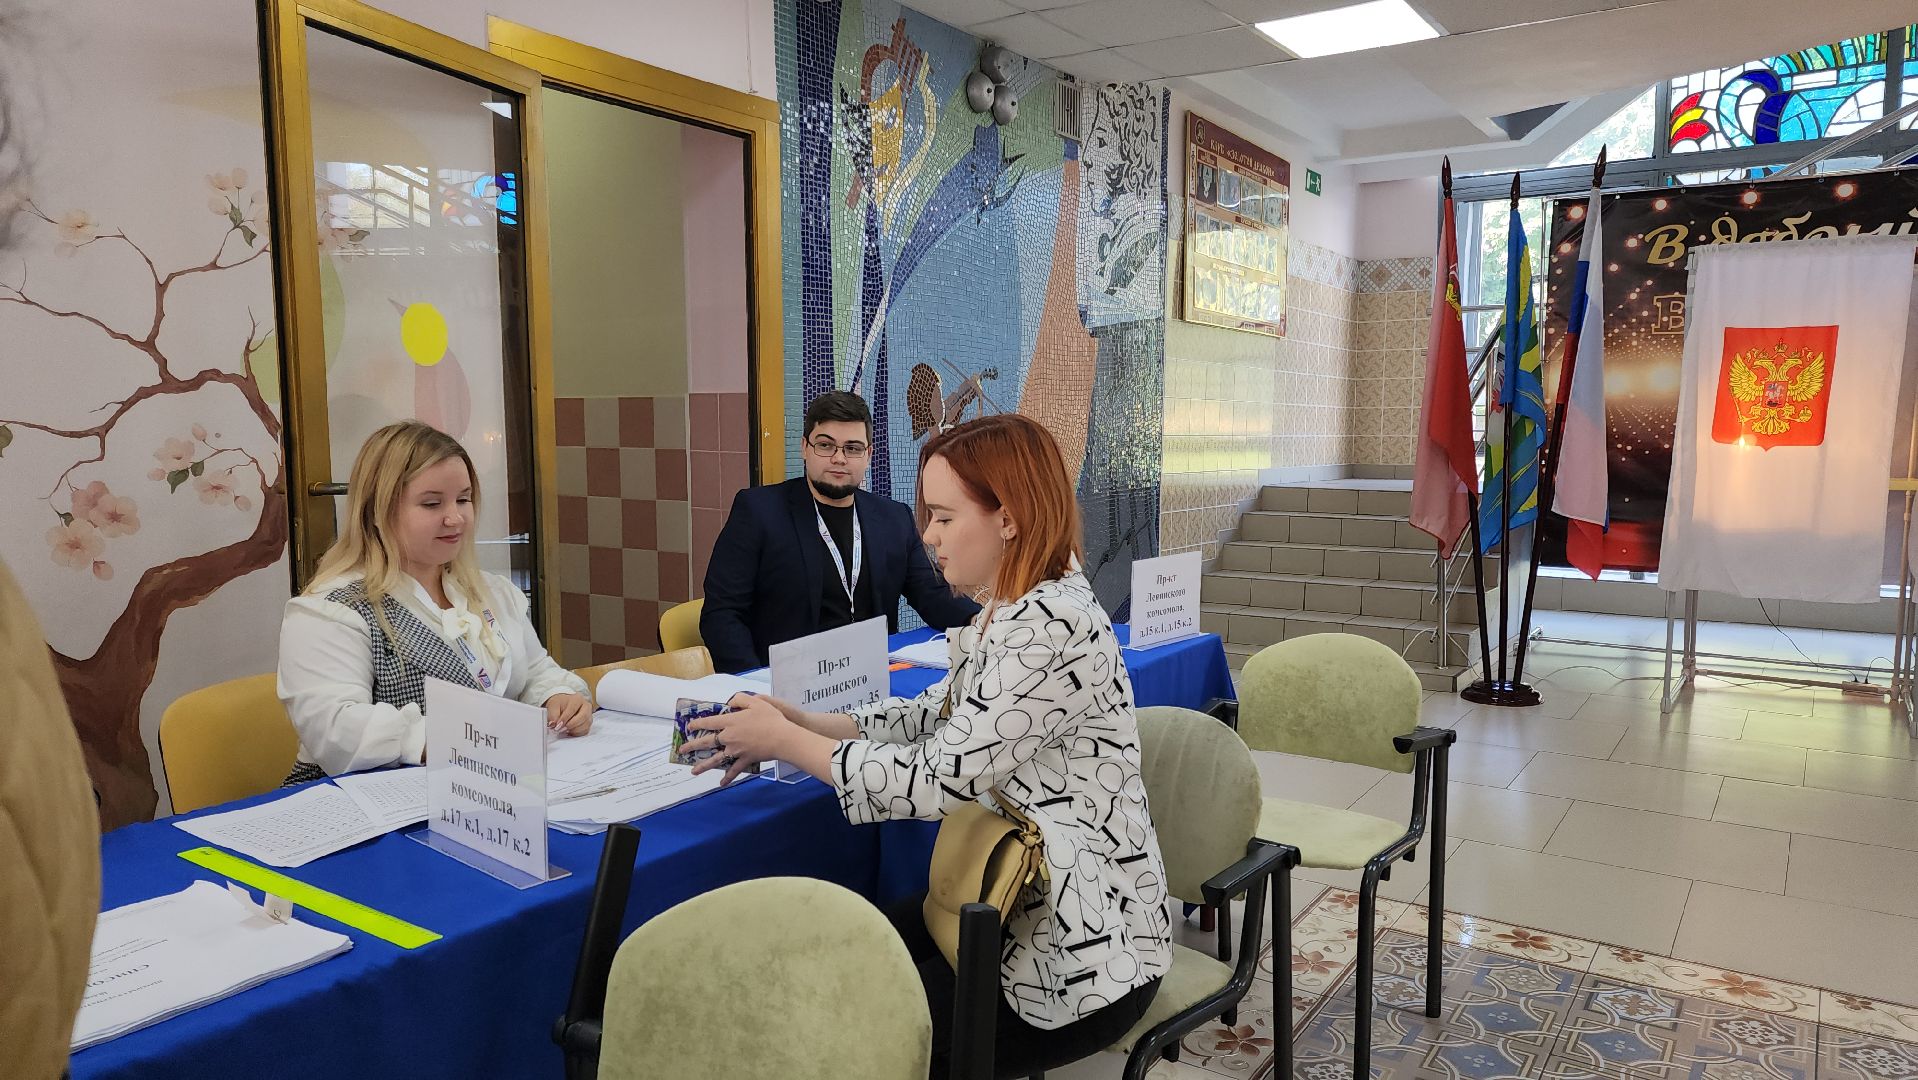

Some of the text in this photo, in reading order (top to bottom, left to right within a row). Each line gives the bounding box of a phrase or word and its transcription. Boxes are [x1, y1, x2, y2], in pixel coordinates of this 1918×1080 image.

[1644, 224, 1690, 264] В
[1157, 574, 1177, 586] Пр-кт
[817, 655, 852, 677] Пр-кт
[801, 674, 868, 705] Ленинского
[464, 722, 499, 750] Пр-кт
[448, 747, 517, 787] Ленинского
[451, 781, 517, 822] комсомола,
[440, 807, 531, 857] д.17 к.1, д.17 к.2
